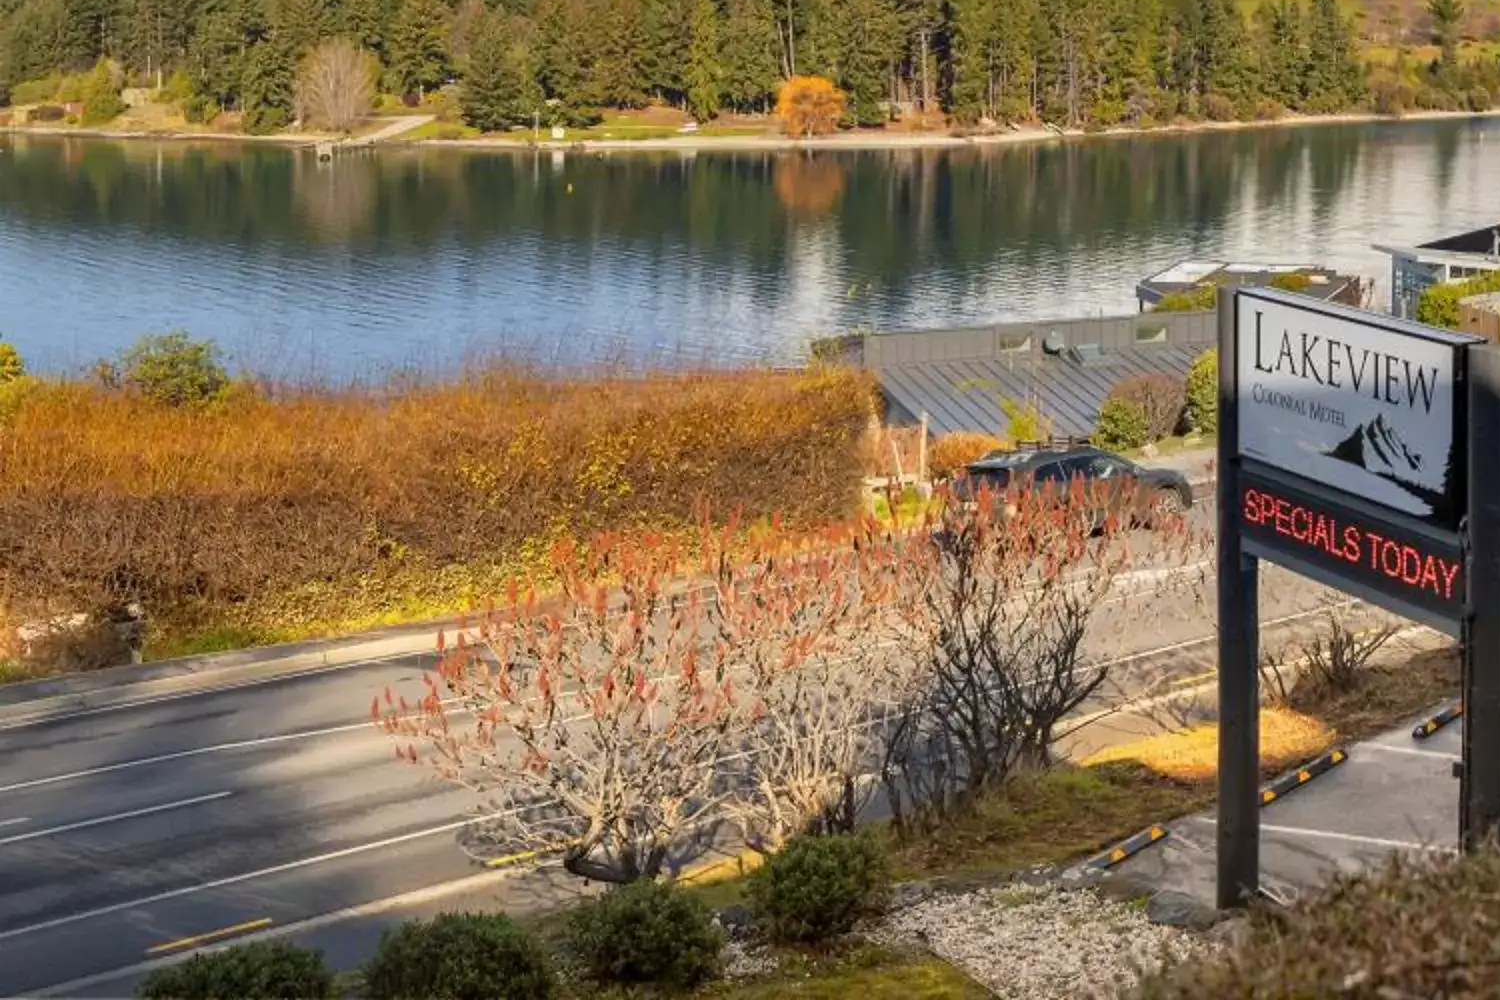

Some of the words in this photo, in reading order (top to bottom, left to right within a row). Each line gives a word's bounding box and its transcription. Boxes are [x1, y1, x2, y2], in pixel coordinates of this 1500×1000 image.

[1254, 311, 1440, 415] LAKEVIEW
[1309, 400, 1346, 428] MOTEL
[1244, 489, 1361, 562] SPECIALS
[1367, 531, 1459, 599] TODAY
